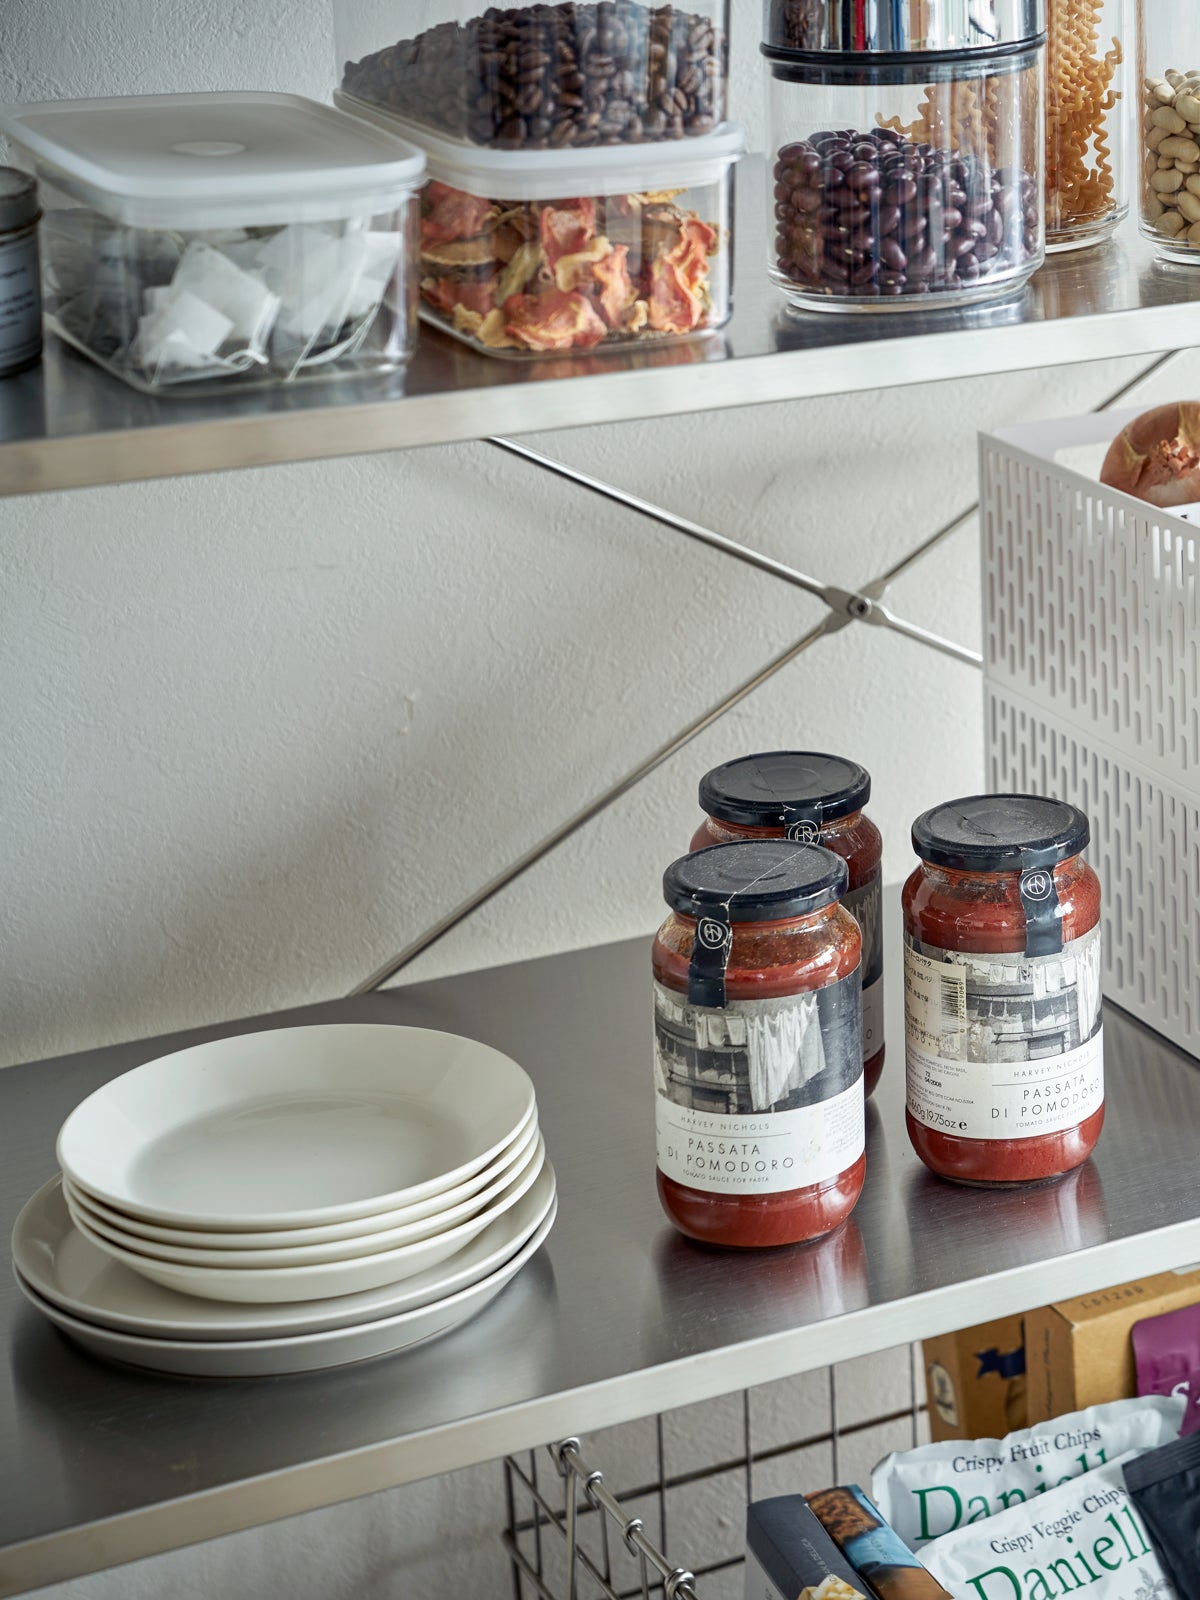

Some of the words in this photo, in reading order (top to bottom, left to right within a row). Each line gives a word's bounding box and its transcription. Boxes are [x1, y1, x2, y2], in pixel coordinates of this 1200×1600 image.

[1013, 1066, 1051, 1078] HARVEY
[991, 1107, 1008, 1119] DI
[1021, 1078, 1100, 1117] POMODORO
[1023, 1074, 1085, 1101] PASSATA
[681, 1116, 714, 1128] HARVEY
[720, 1122, 770, 1131] NICHOLS
[1016, 1120, 1043, 1128] TOMATO
[688, 1138, 760, 1155] PASSATA
[667, 1145, 678, 1160] DI
[687, 1154, 794, 1173] POMODORO
[708, 1175, 729, 1183] SAUCE
[952, 1455, 1005, 1474] Crispy
[1009, 1442, 1050, 1463] Fruit
[1053, 1427, 1102, 1453] Chips
[989, 1531, 1033, 1555] Crispy
[1032, 1509, 1083, 1538] Veggie
[1082, 1484, 1127, 1515] Chips
